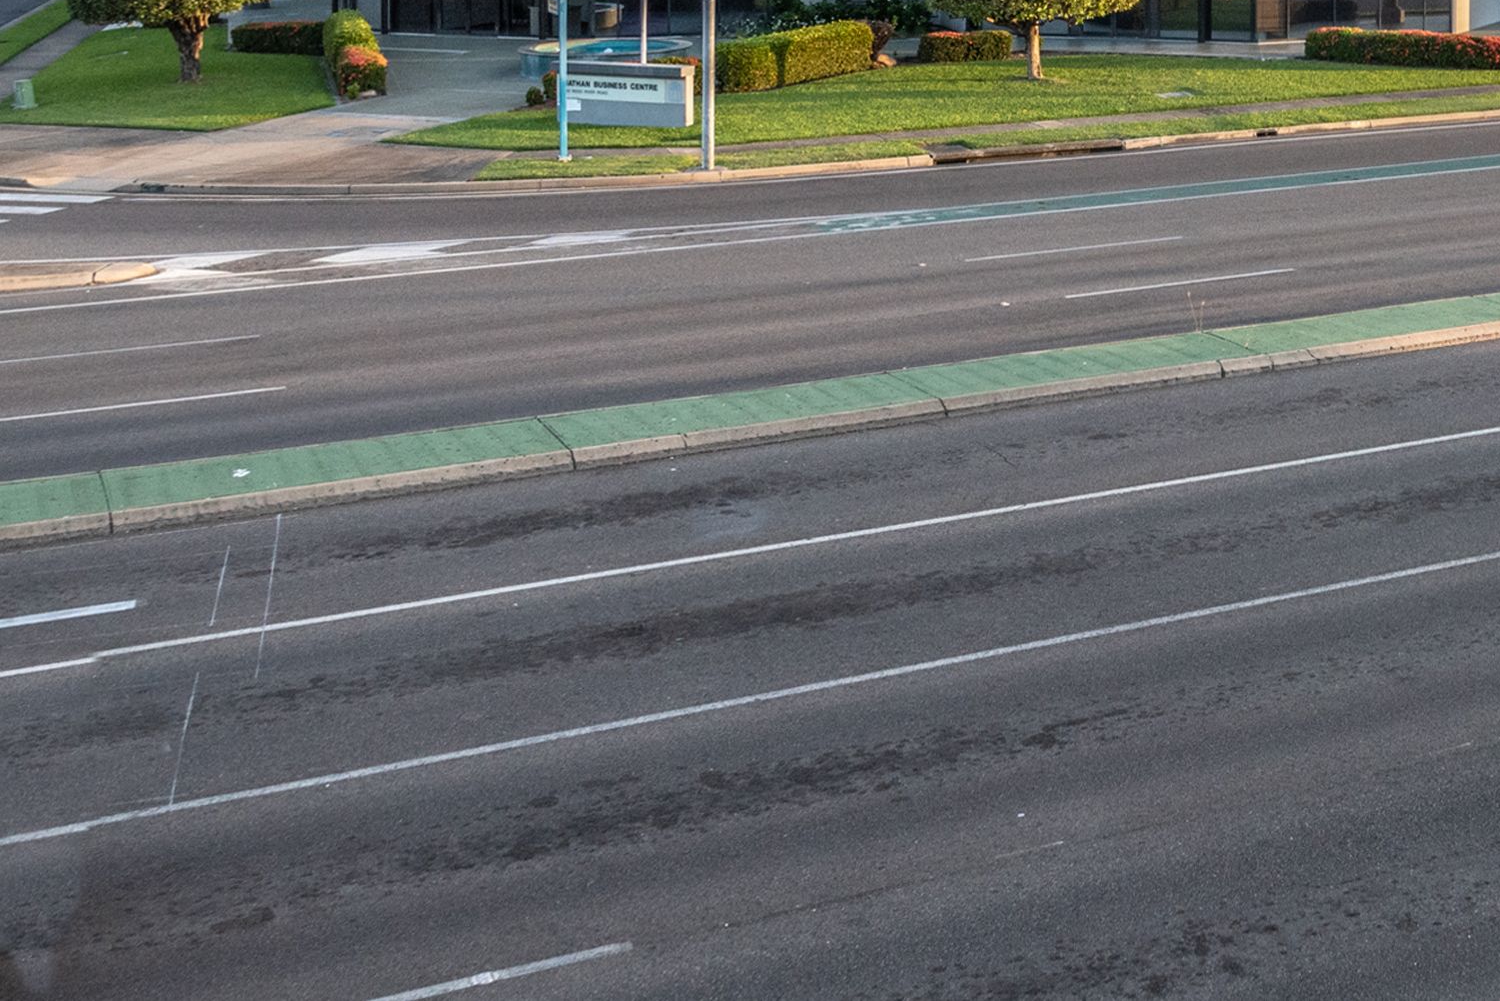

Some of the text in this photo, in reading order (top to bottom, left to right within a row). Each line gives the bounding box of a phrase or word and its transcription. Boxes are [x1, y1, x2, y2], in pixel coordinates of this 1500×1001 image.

[566, 79, 659, 92] ATHAN BUSINESS CENTRE
